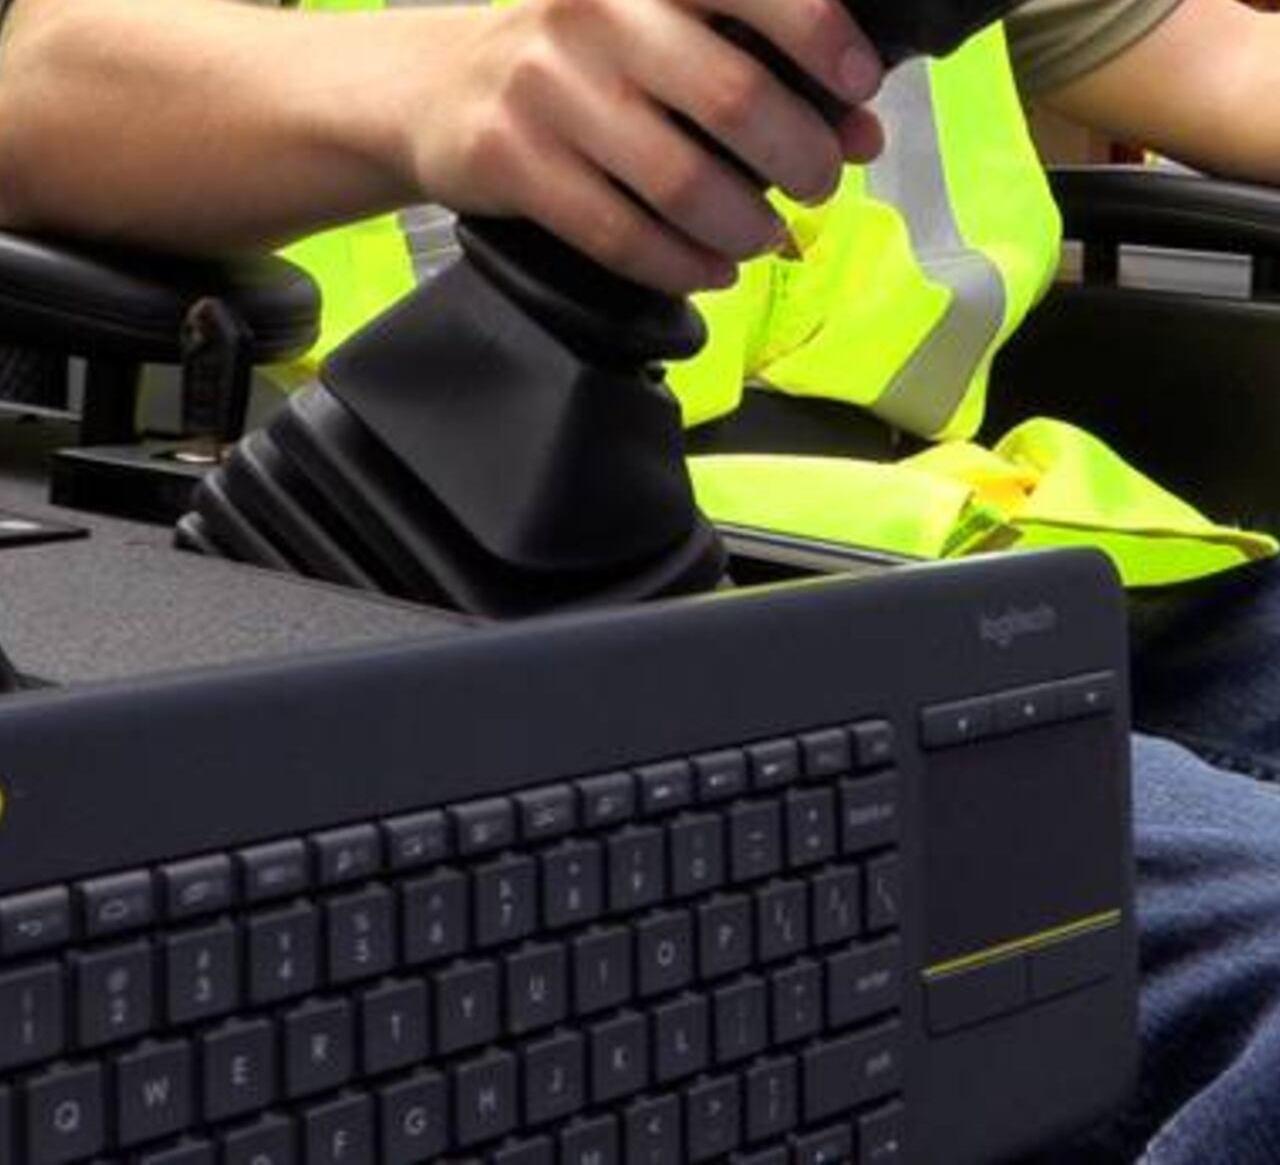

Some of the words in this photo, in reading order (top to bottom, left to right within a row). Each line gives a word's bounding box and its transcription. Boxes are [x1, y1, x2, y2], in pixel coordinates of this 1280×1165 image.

[232, 1055, 249, 1085] E
[143, 1076, 170, 1108] W
[477, 1088, 498, 1115] H
[54, 1100, 80, 1132] Q
[404, 1106, 427, 1135] G
